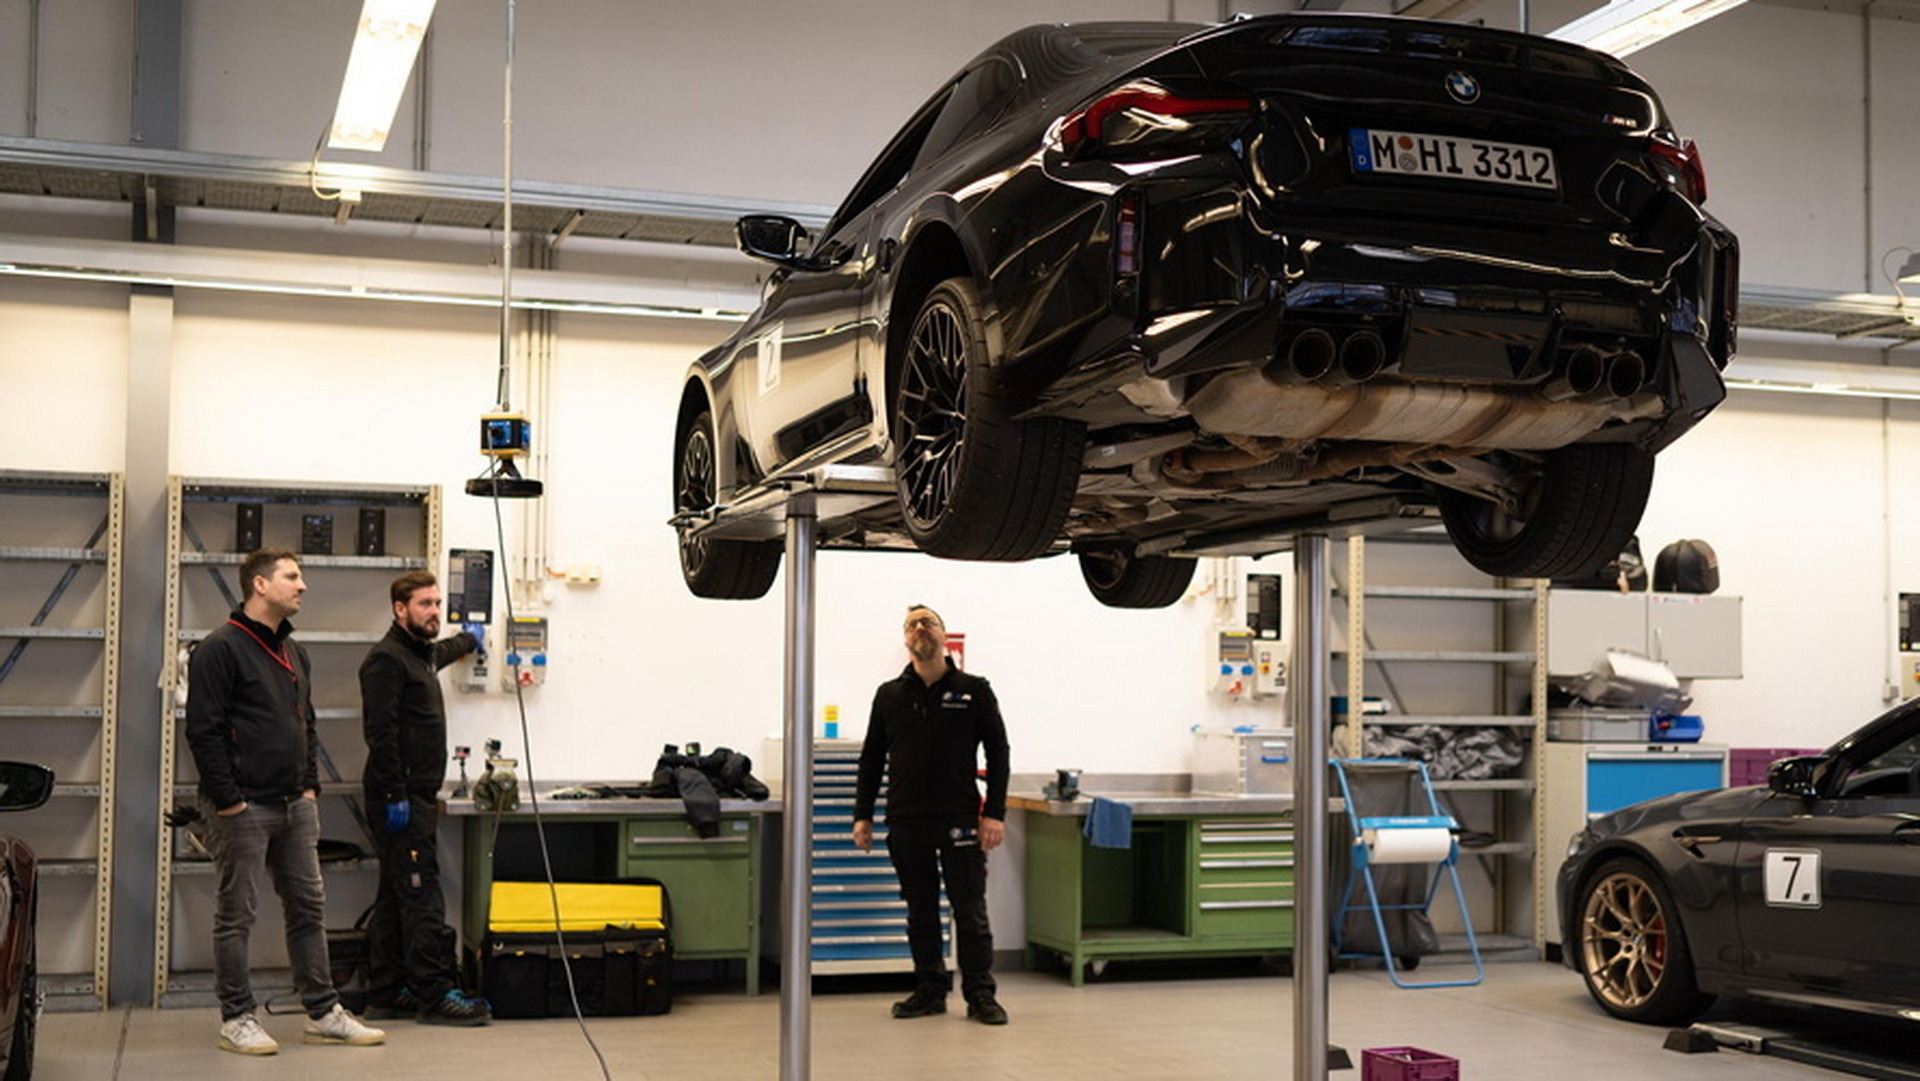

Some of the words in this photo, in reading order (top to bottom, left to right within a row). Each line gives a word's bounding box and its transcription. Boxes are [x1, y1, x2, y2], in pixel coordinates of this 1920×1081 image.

[1357, 154, 1367, 166] D
[1372, 135, 1397, 169] M
[1418, 138, 1463, 175] HI
[1471, 143, 1555, 186] 3312
